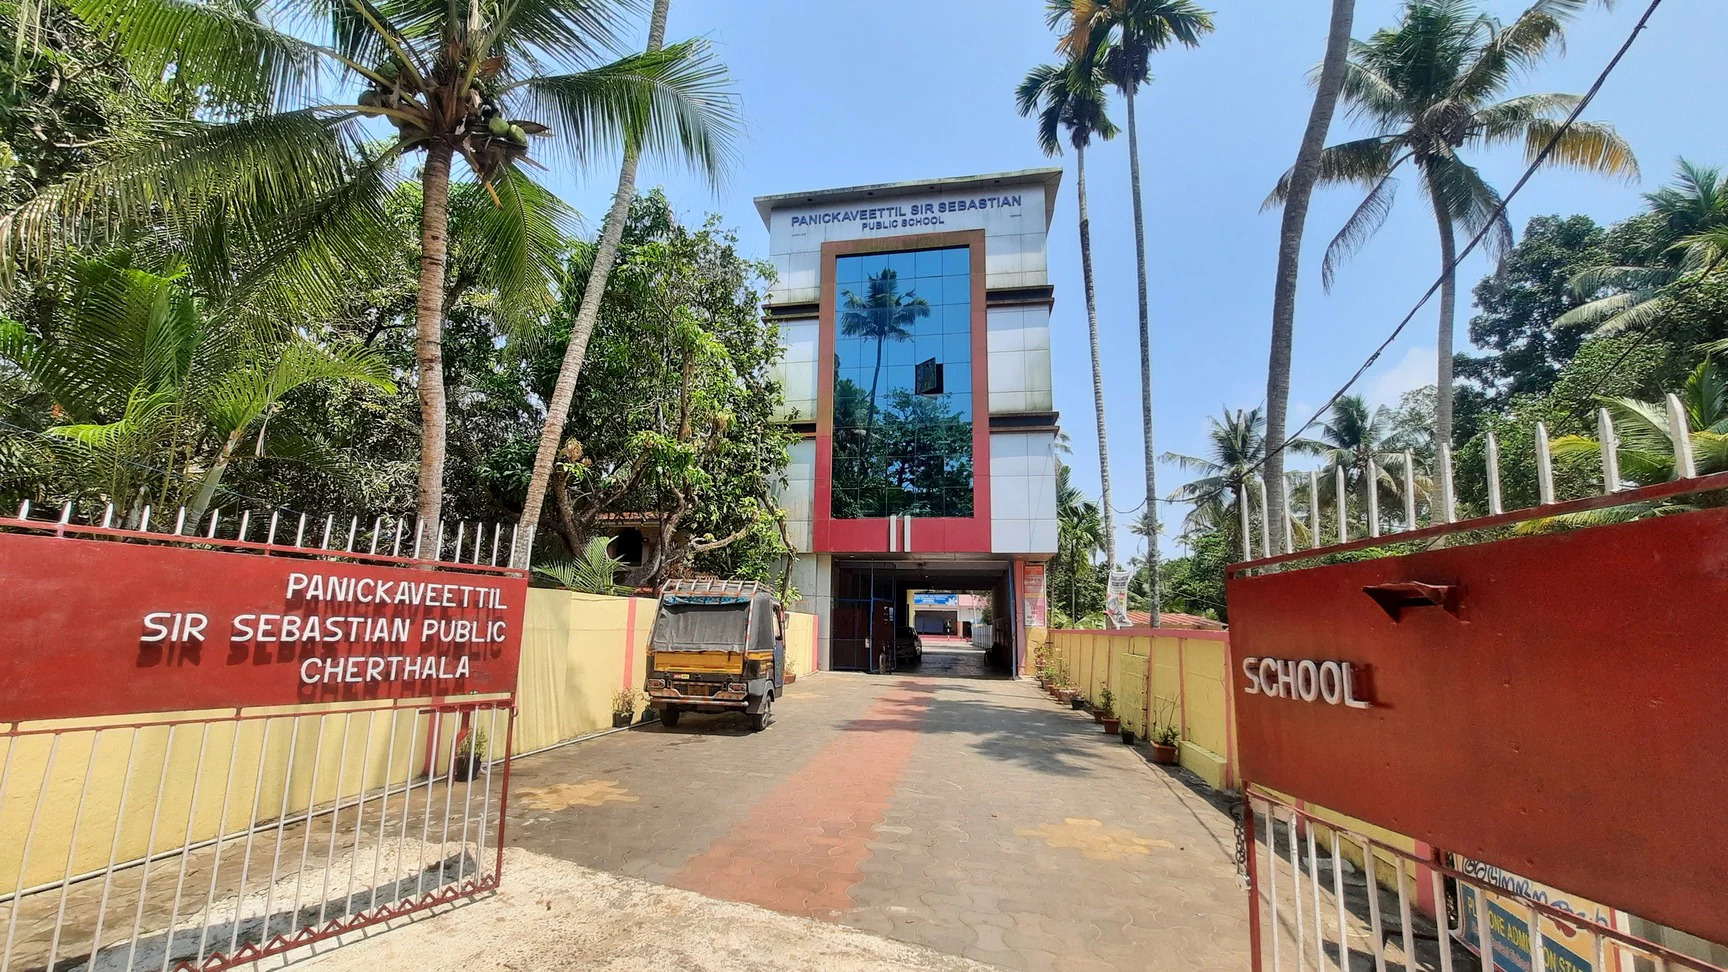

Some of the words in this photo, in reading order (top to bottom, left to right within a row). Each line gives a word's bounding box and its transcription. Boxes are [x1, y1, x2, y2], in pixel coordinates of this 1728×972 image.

[791, 206, 907, 227] PANICKAVEETTIL
[910, 203, 934, 216] SIR
[938, 195, 1022, 213] SEBASTIAN
[861, 219, 898, 231] PUBLIC
[901, 216, 944, 227] SCHOOL
[286, 572, 508, 610] PANICKAVEETTIL
[140, 612, 209, 643] SIR
[230, 613, 408, 643] SEBASTIAN
[420, 618, 507, 643] PUBLIC
[299, 655, 470, 684] CHERTHALA
[1242, 657, 1370, 709] SCHOOL
[1488, 910, 1506, 937] ONE
